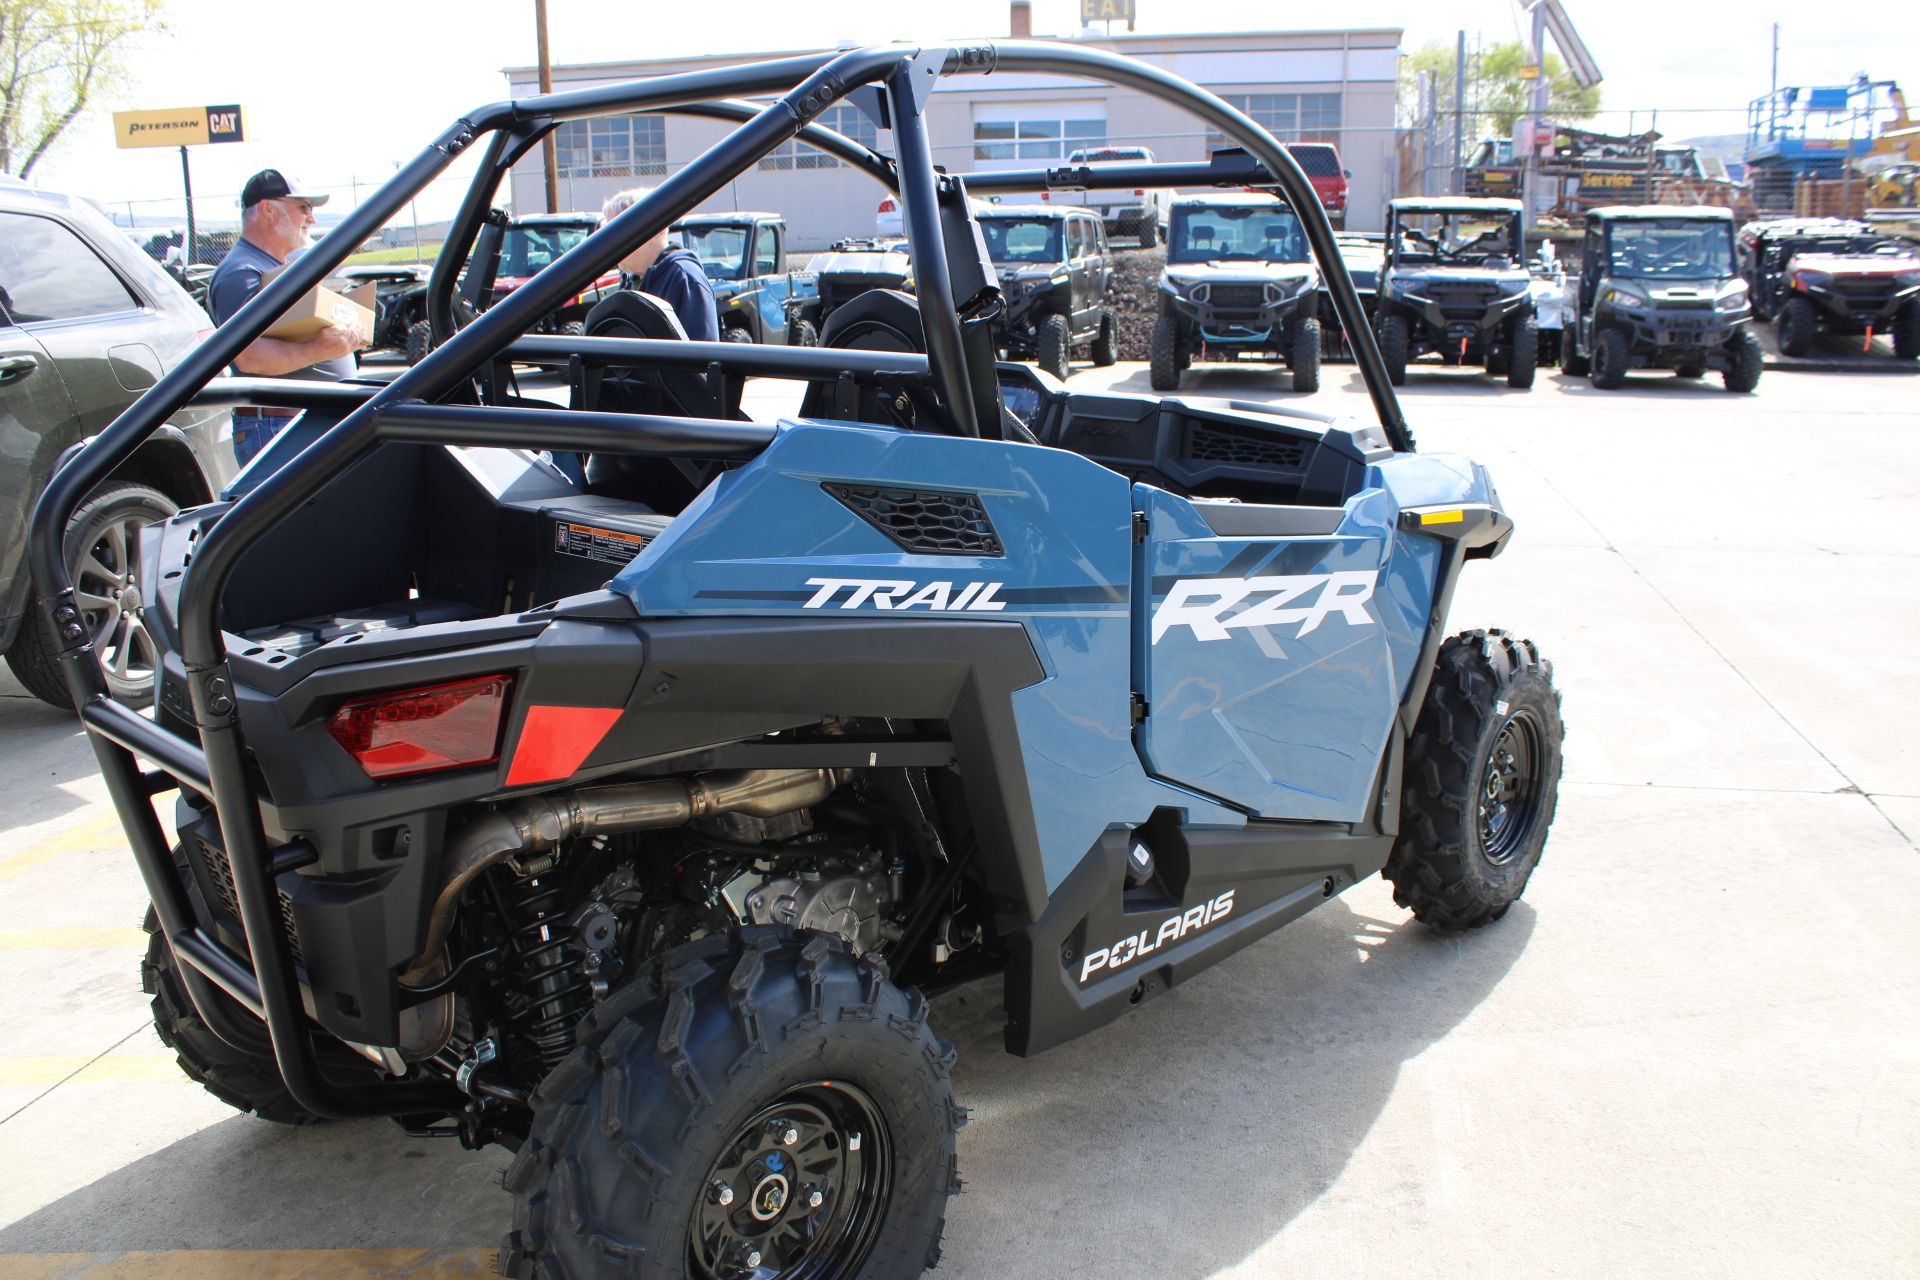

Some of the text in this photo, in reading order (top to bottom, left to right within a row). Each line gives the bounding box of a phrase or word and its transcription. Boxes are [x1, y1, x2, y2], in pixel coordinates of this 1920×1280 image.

[129, 112, 236, 135] PETERSON CAT
[1583, 173, 1633, 187] Service
[802, 577, 1008, 611] TRAIL
[1151, 569, 1379, 646] RZR
[1079, 888, 1236, 983] POLARIS
